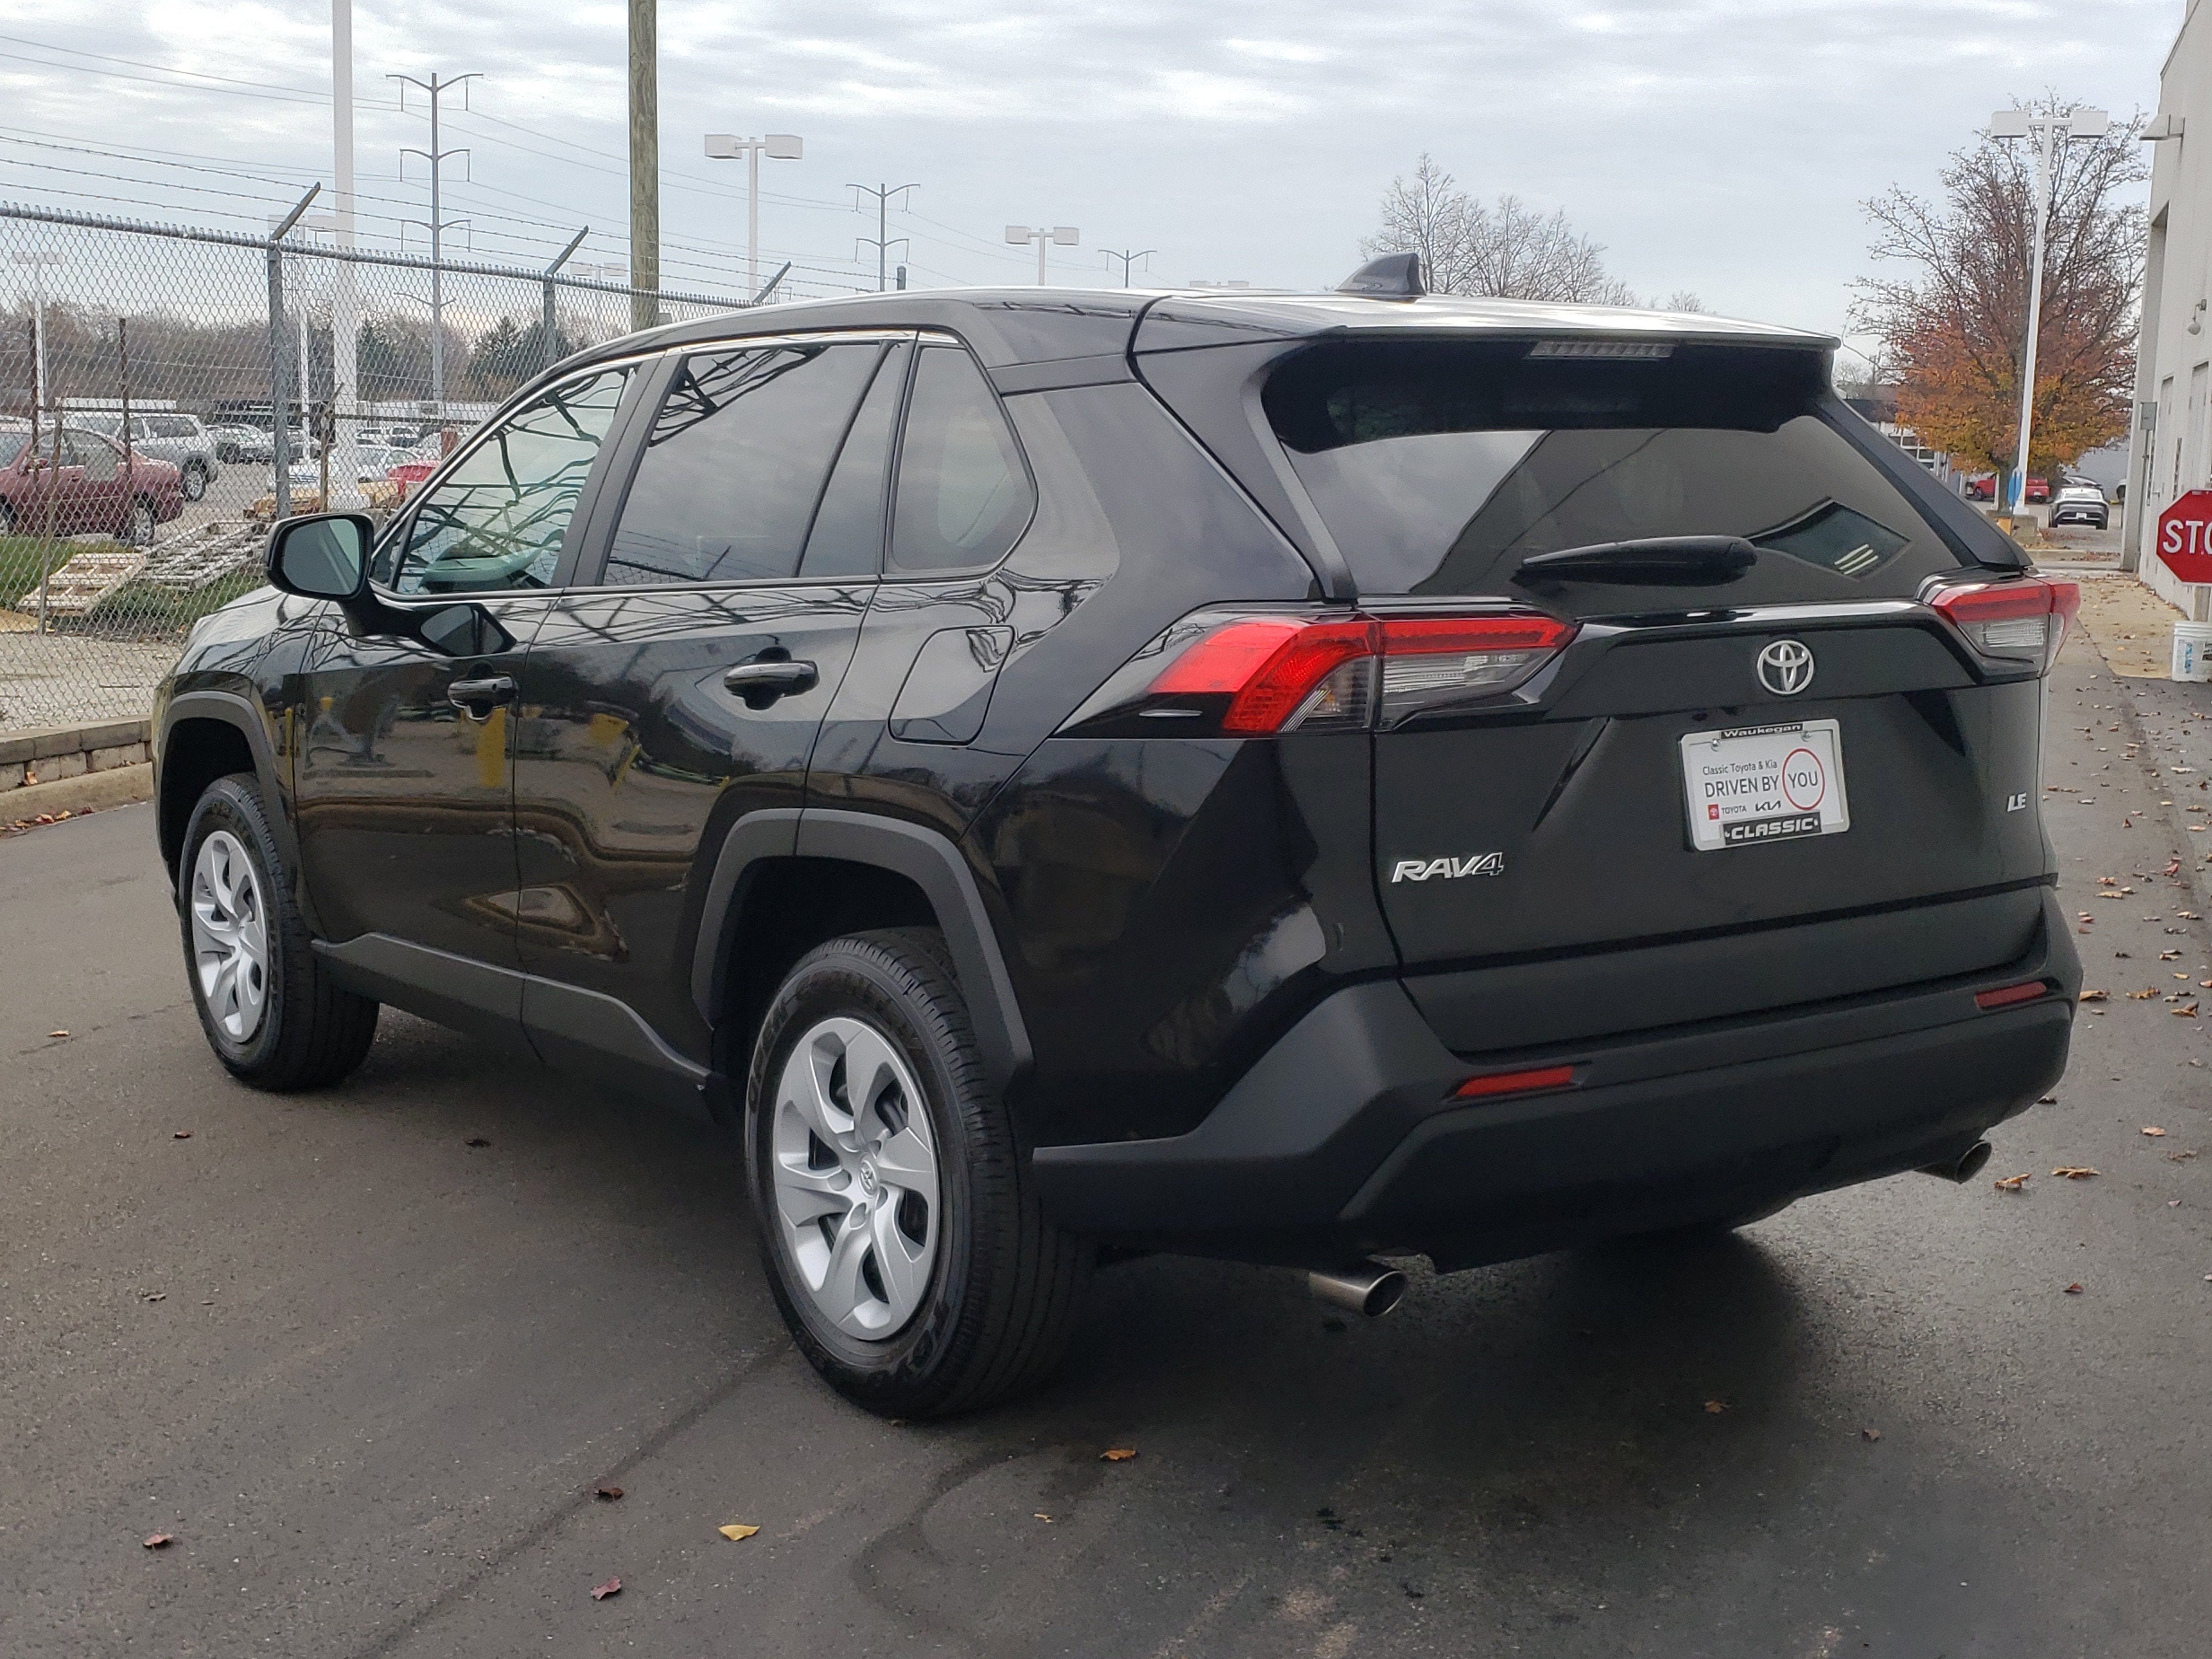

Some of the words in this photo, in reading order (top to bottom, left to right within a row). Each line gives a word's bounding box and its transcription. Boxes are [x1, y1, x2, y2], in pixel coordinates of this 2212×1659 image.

[1724, 724, 1801, 737] Waukegan
[1702, 764, 1728, 775] Classic
[1730, 762, 1756, 774] Toyota
[1758, 760, 1763, 769] &
[1765, 759, 1778, 769] Kia
[1705, 777, 1758, 798] DRIVEN
[1762, 775, 1779, 791] BY
[1788, 771, 1818, 789] YOU
[1721, 805, 1747, 815] TOYOTA
[2007, 792, 2027, 812] LE
[1731, 817, 1814, 840] CLASSIC
[1391, 852, 1504, 883] RAV4
